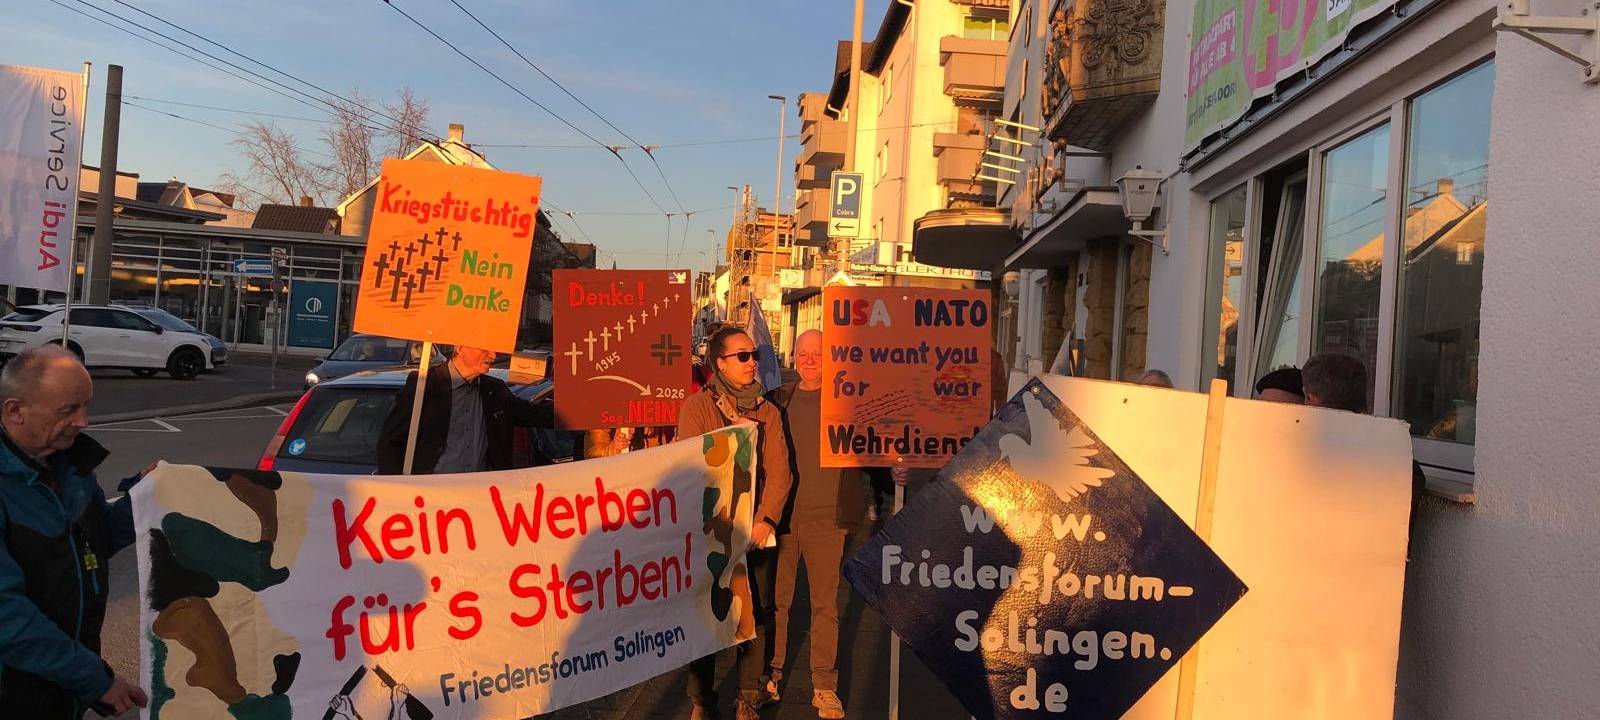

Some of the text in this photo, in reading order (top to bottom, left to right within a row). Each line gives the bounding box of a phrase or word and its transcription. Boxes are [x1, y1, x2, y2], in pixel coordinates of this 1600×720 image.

[837, 178, 857, 205] P
[460, 249, 514, 280] Nein
[569, 281, 645, 307] Denke!
[833, 299, 988, 327] USA NATO
[595, 351, 621, 372] 1945
[831, 341, 979, 370] we want you
[655, 387, 685, 399] 2026
[833, 370, 982, 398] for war
[332, 477, 678, 569] Kein Werben
[881, 544, 1195, 605] Friedensforum-
[326, 532, 692, 661] für's Sterben!
[954, 609, 1172, 671] Solingen.
[440, 624, 686, 706] Friedensforum Solingen
[1009, 667, 1069, 713] de
